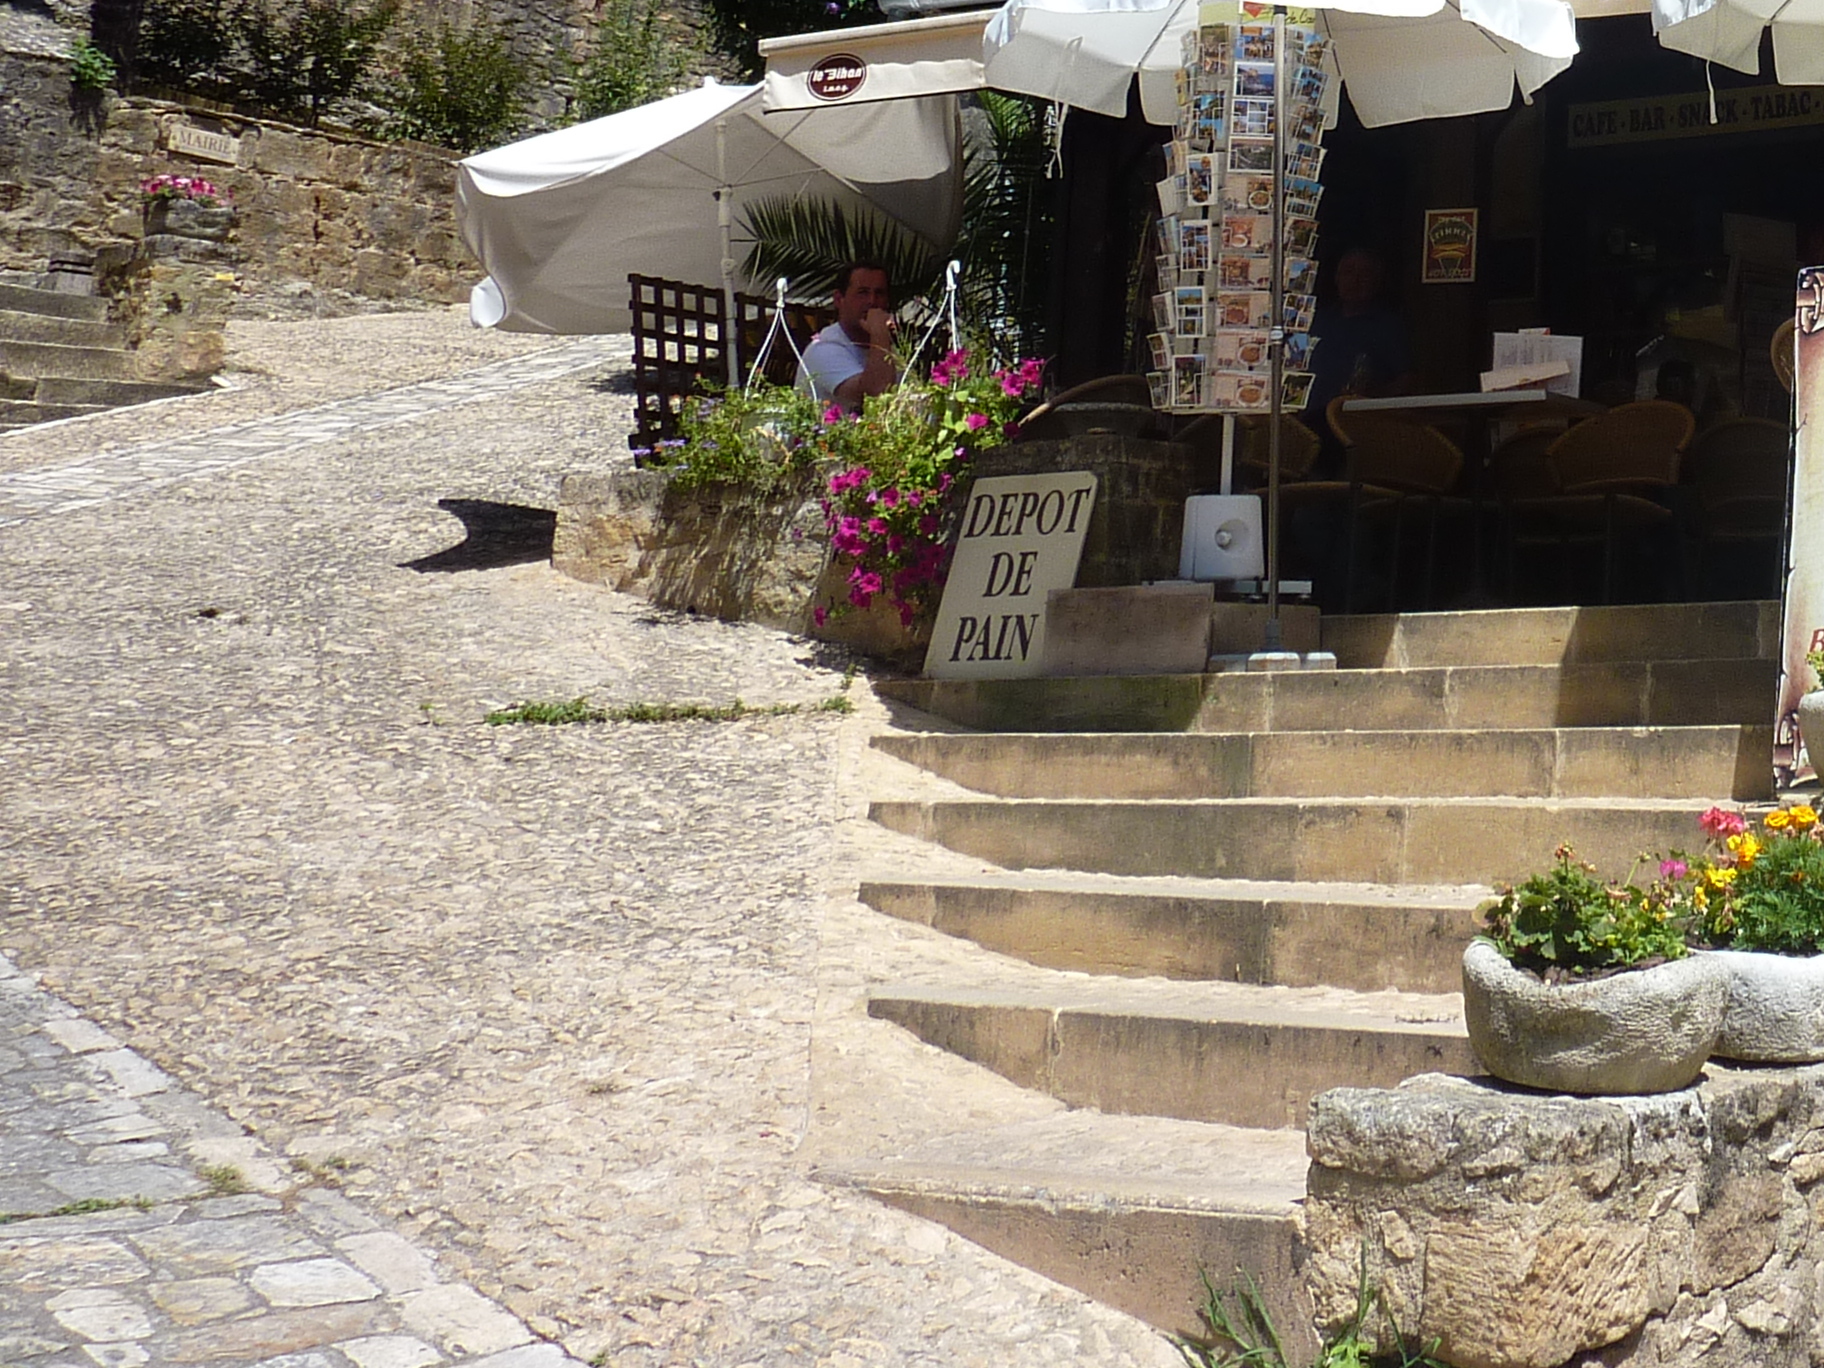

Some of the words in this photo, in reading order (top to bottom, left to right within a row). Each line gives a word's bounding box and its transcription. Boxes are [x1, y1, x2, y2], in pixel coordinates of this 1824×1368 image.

[1572, 111, 1618, 137] CAFE
[1629, 106, 1666, 132] BAR
[1751, 91, 1811, 121] TABAC
[180, 130, 231, 154] MAIRIE
[964, 486, 1092, 539] DEPOT
[982, 551, 1038, 598] DE
[949, 613, 1039, 663] PAIN
